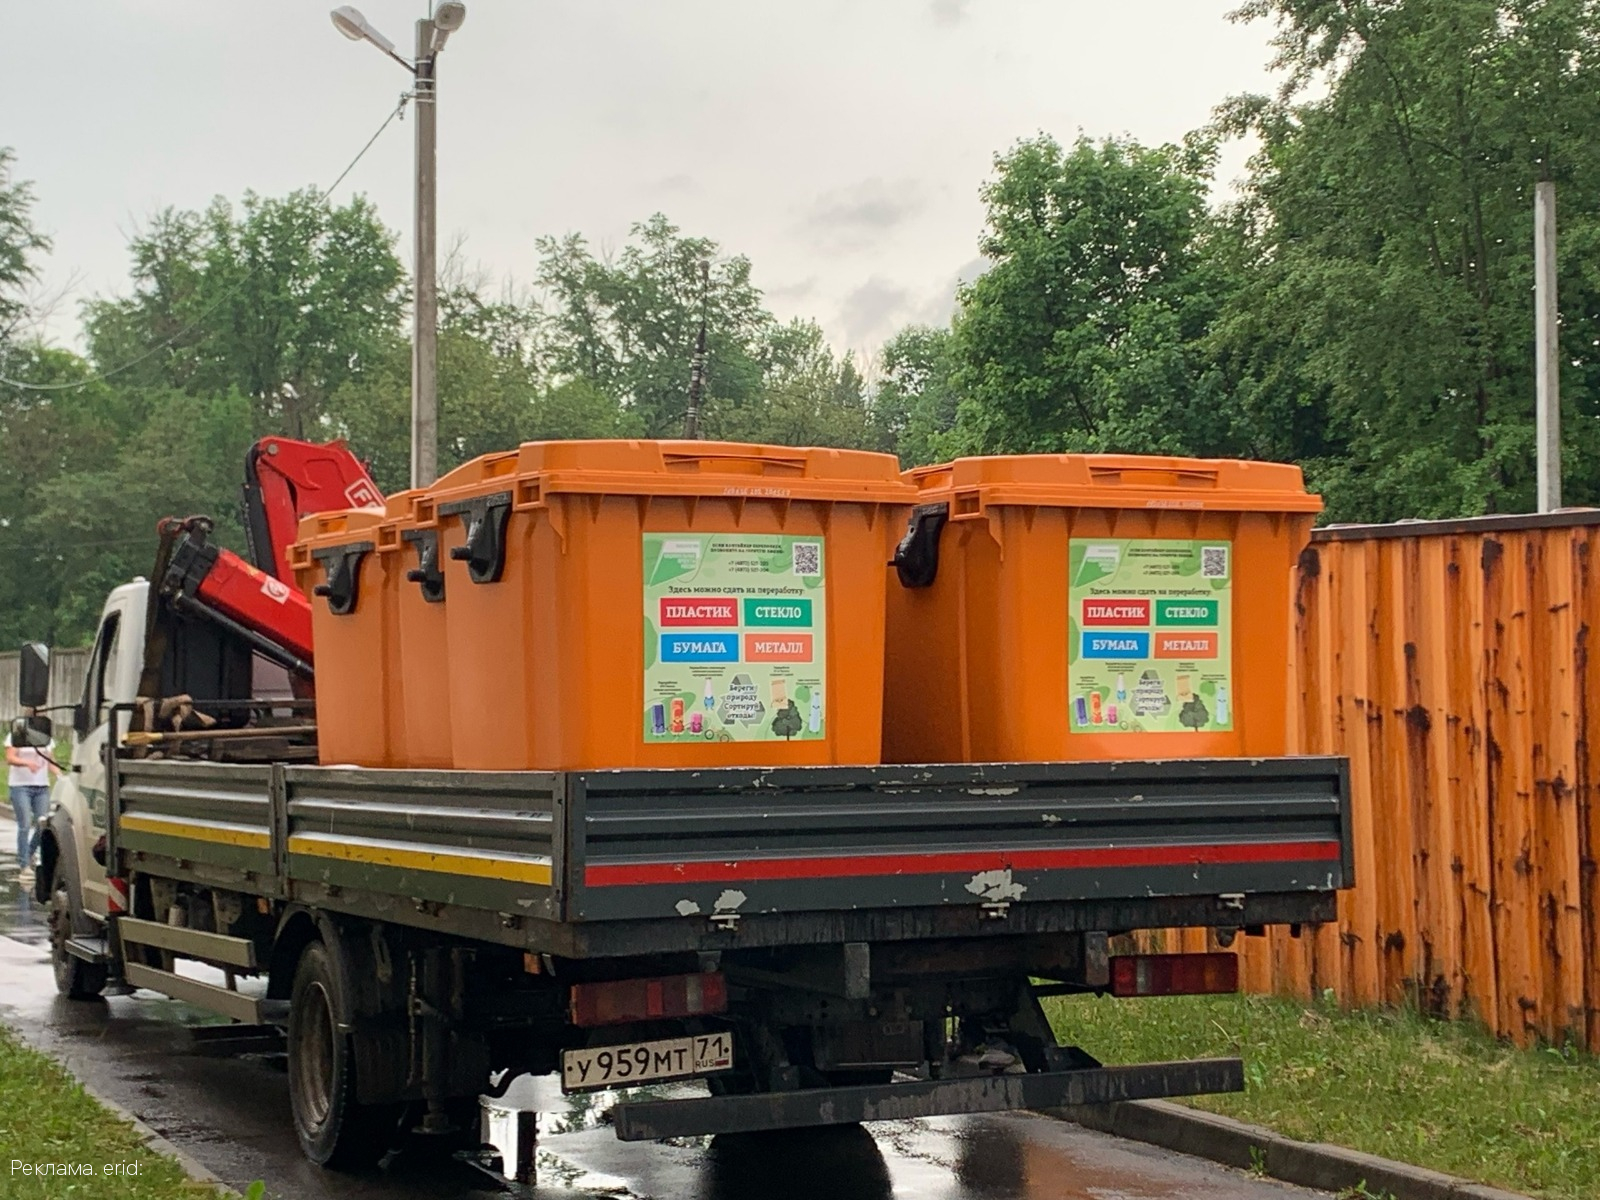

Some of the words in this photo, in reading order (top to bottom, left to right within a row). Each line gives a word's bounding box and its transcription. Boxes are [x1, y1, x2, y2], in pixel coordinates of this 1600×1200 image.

[668, 585, 692, 594] Здесь
[723, 586, 745, 594] сдать
[665, 606, 732, 618] ПЛАСТИК
[755, 607, 802, 619] СТЕКЛО
[1087, 606, 1145, 618] ПЛАСТИК
[1165, 607, 1209, 618] СТЕКЛО
[673, 642, 727, 654] БУМАГА
[754, 642, 803, 654] МЕТАЛЛ
[1092, 639, 1139, 651] БУМАГА
[1163, 640, 1209, 651] МЕТАЛЛ
[697, 1036, 723, 1060] 71
[695, 1058, 715, 1069] RUS
